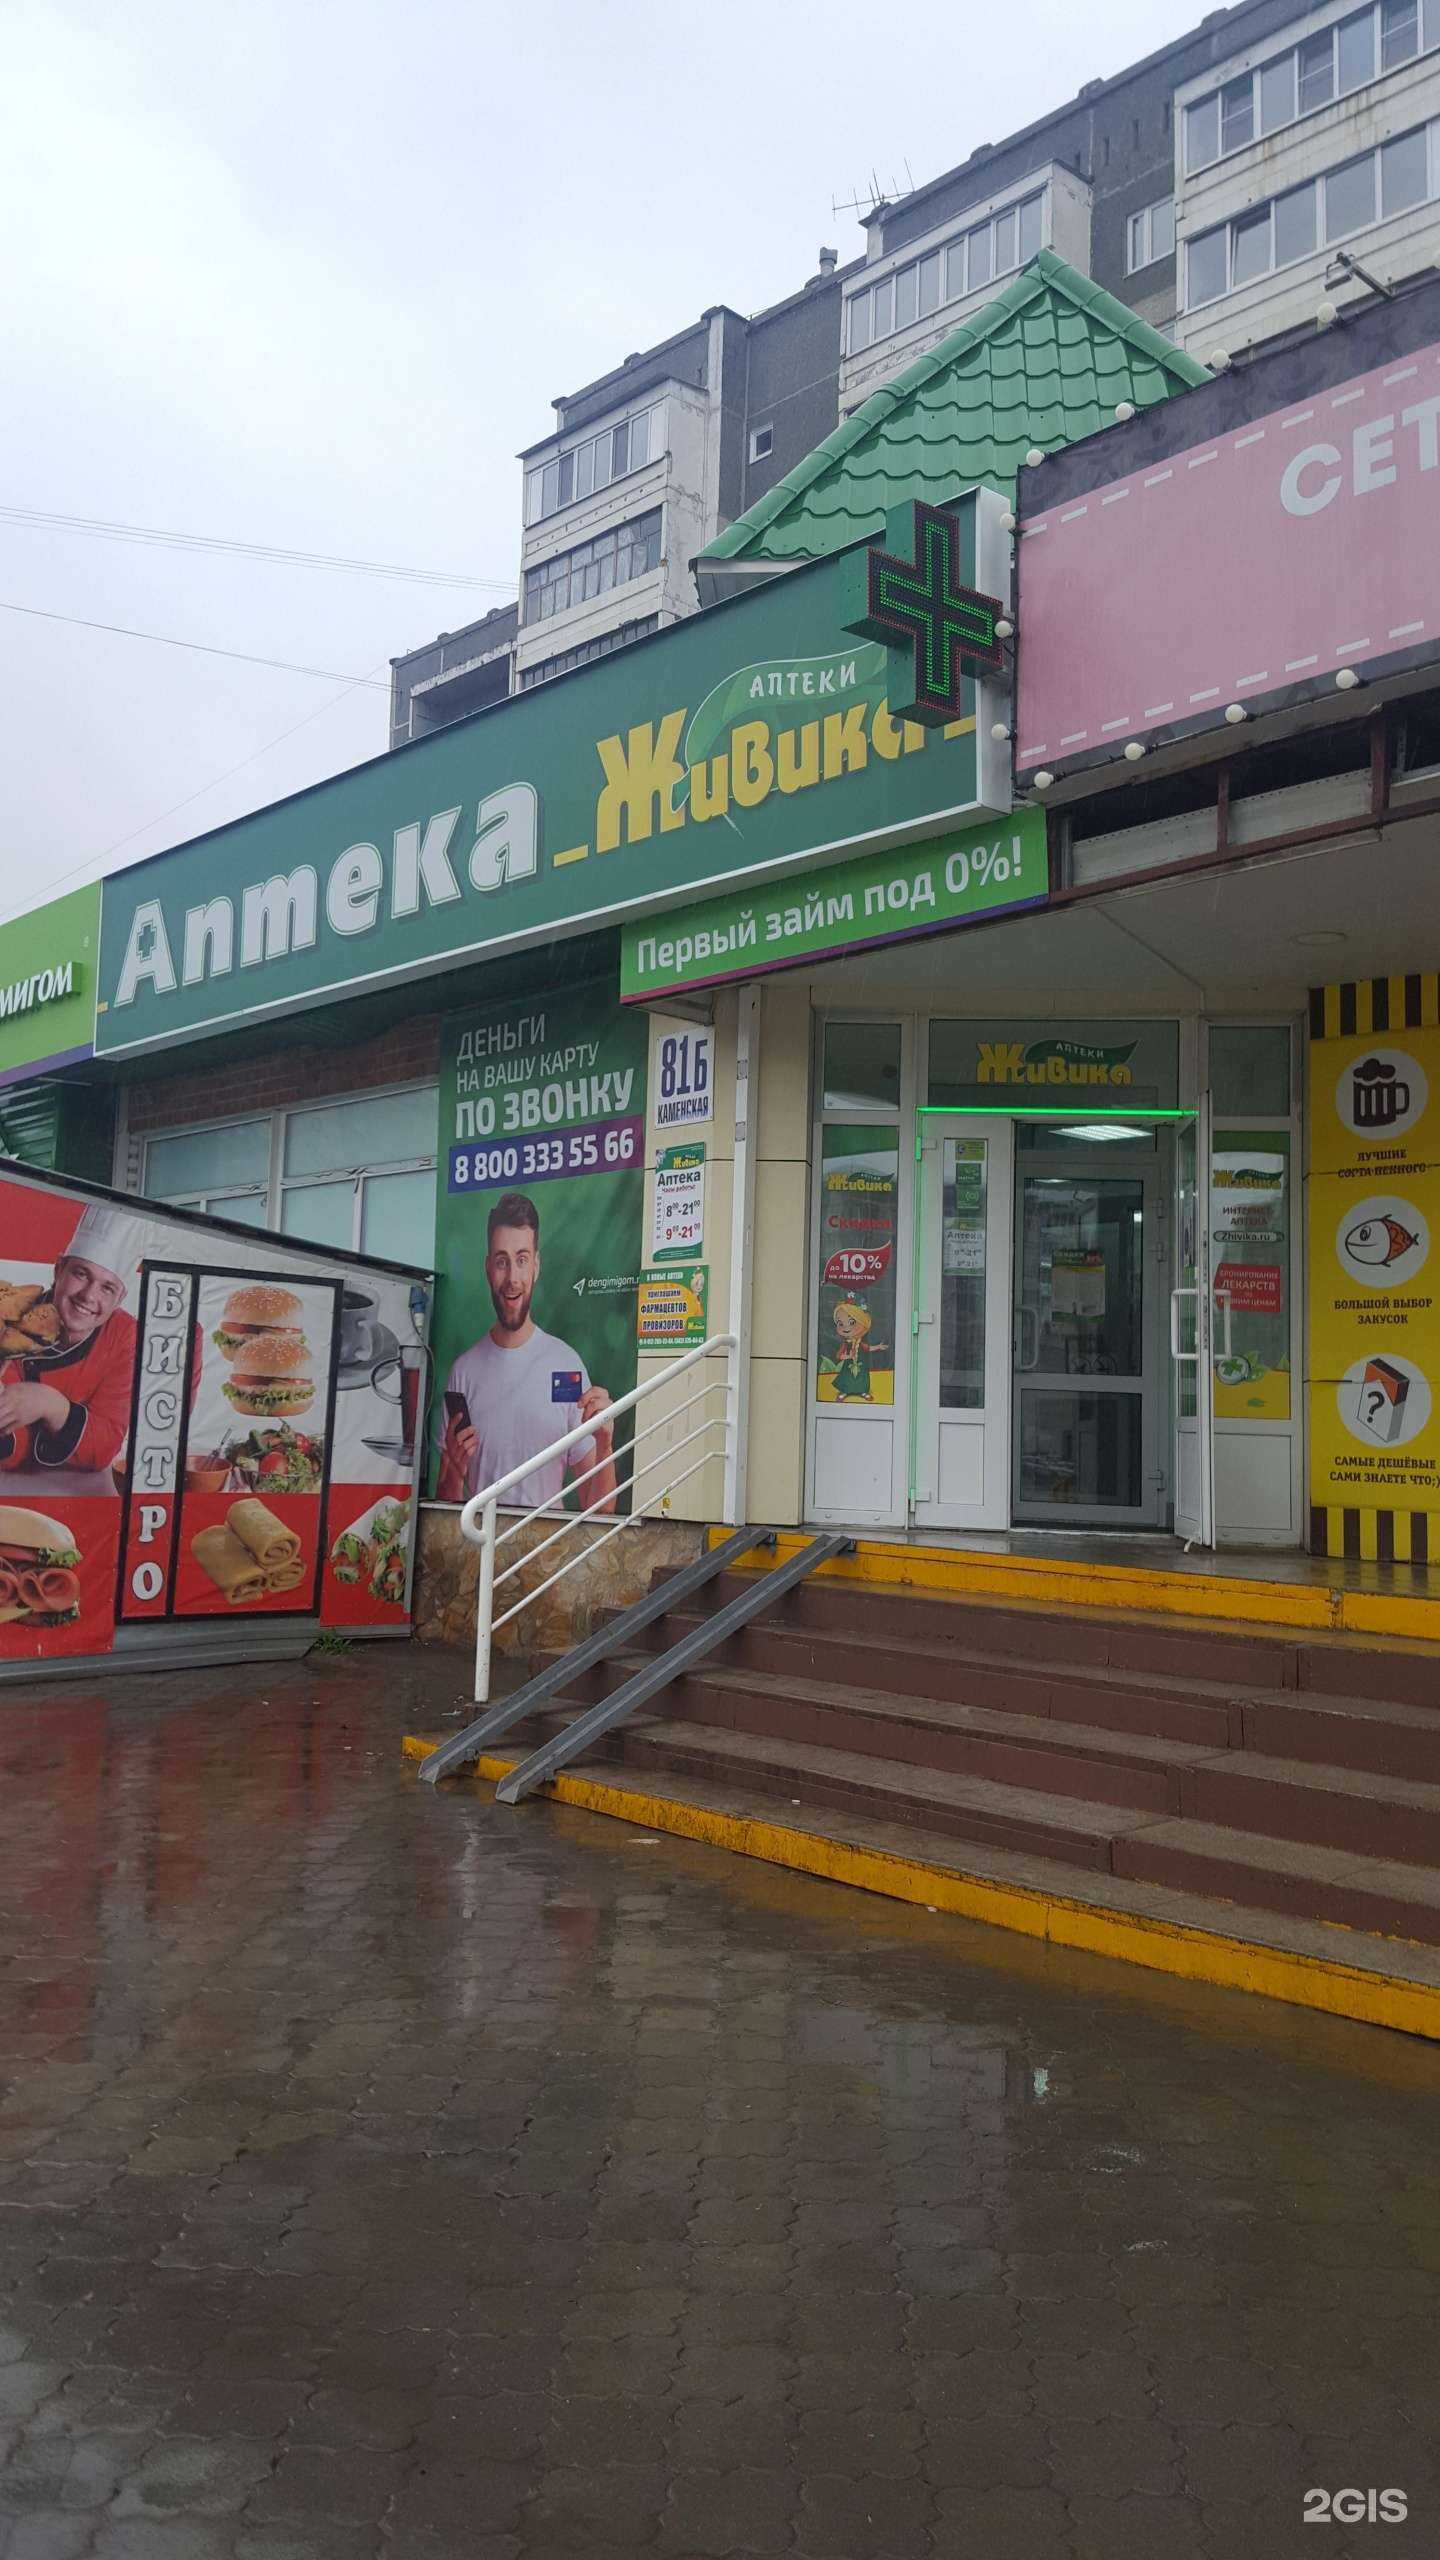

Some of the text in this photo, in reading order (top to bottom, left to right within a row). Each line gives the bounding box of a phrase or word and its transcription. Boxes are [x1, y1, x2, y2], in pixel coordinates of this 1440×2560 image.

[1281, 394, 1440, 517] СЕТ
[750, 661, 856, 698] АПТЕКИ
[114, 781, 538, 1008] Аптека
[637, 836, 1022, 974] Первый займ под 0%!
[456, 1014, 545, 1067] ДЕНЬГИ
[1055, 1042, 1104, 1059] АПТЕКИ
[457, 1041, 599, 1094] НА ВАШУ КАРТУ
[661, 1035, 708, 1098] 81Б
[976, 1042, 1133, 1086] Живика
[455, 1068, 634, 1139] ПО ЗВОНКУ
[657, 1096, 709, 1124] КАМЕНСКАЯ
[454, 1127, 634, 1184] 8 800 333 55 66
[1357, 1149, 1407, 1161] ЛУЧШИЕ
[657, 1171, 701, 1187] Аптека
[1338, 1163, 1426, 1178] СОРТА ПЕННОГО
[828, 1173, 892, 1191] Живика
[840, 1254, 882, 1274] 10%
[588, 1275, 639, 1290] dengimigom.r
[1222, 1280, 1276, 1291] ЛЕКАРСТВ
[640, 1302, 688, 1314] ФАРМАЦЕВТОВ
[1334, 1296, 1433, 1309] БОЛЬШОЙ ВЫБОР
[642, 1320, 684, 1331] ПРОВИЗОРОВ
[1357, 1314, 1408, 1325] ЗАКУСОК
[131, 1278, 184, 1601] БИСТРО
[1334, 1456, 1436, 1469] САМЫЕ ДЕШЁВЫЕ
[1330, 1472, 1361, 1482] САМИ
[1364, 1473, 1407, 1484] ЗНАЕТЕ
